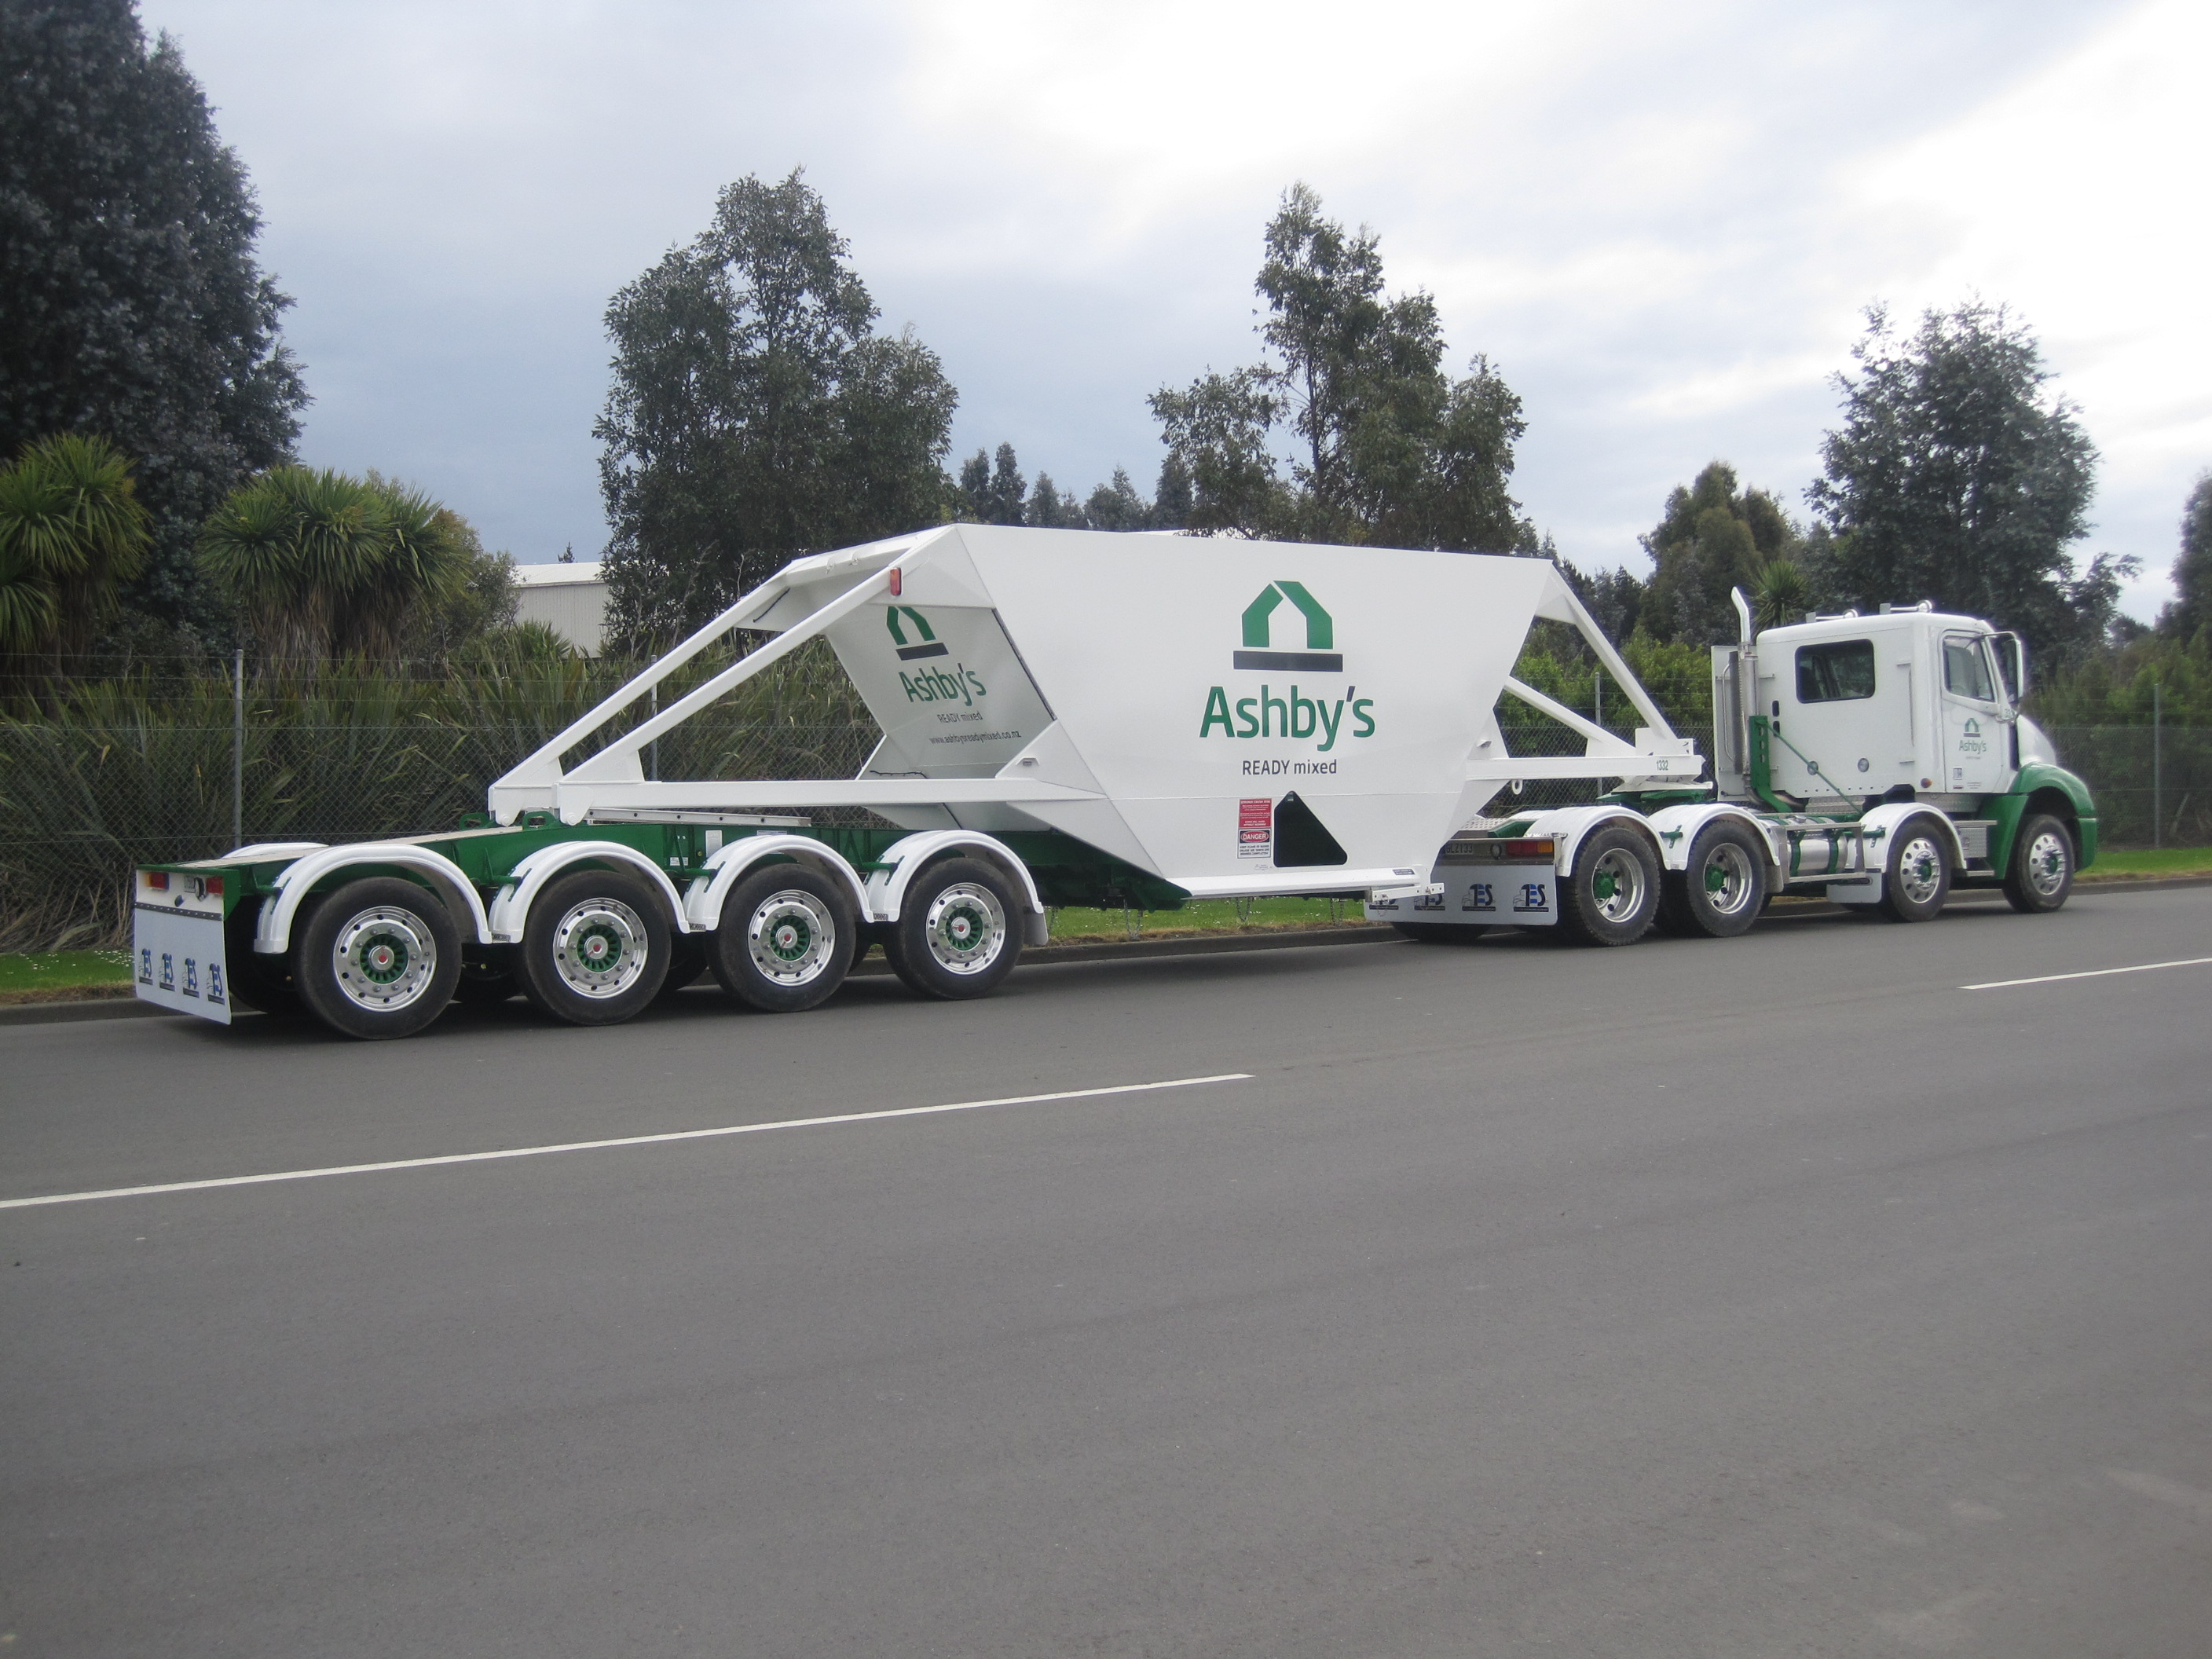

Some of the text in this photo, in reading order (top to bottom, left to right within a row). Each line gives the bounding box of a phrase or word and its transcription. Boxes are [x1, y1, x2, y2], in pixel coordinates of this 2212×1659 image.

[899, 662, 987, 706] Ashby's
[936, 710, 983, 723] READY mixed
[1199, 684, 1375, 752] Ashby's
[928, 730, 1022, 745] www.ashbysreadymixed.co.nz
[1958, 740, 1987, 754] Ashby's
[1242, 759, 1337, 775] READY mixed
[1656, 760, 1668, 771] 1332
